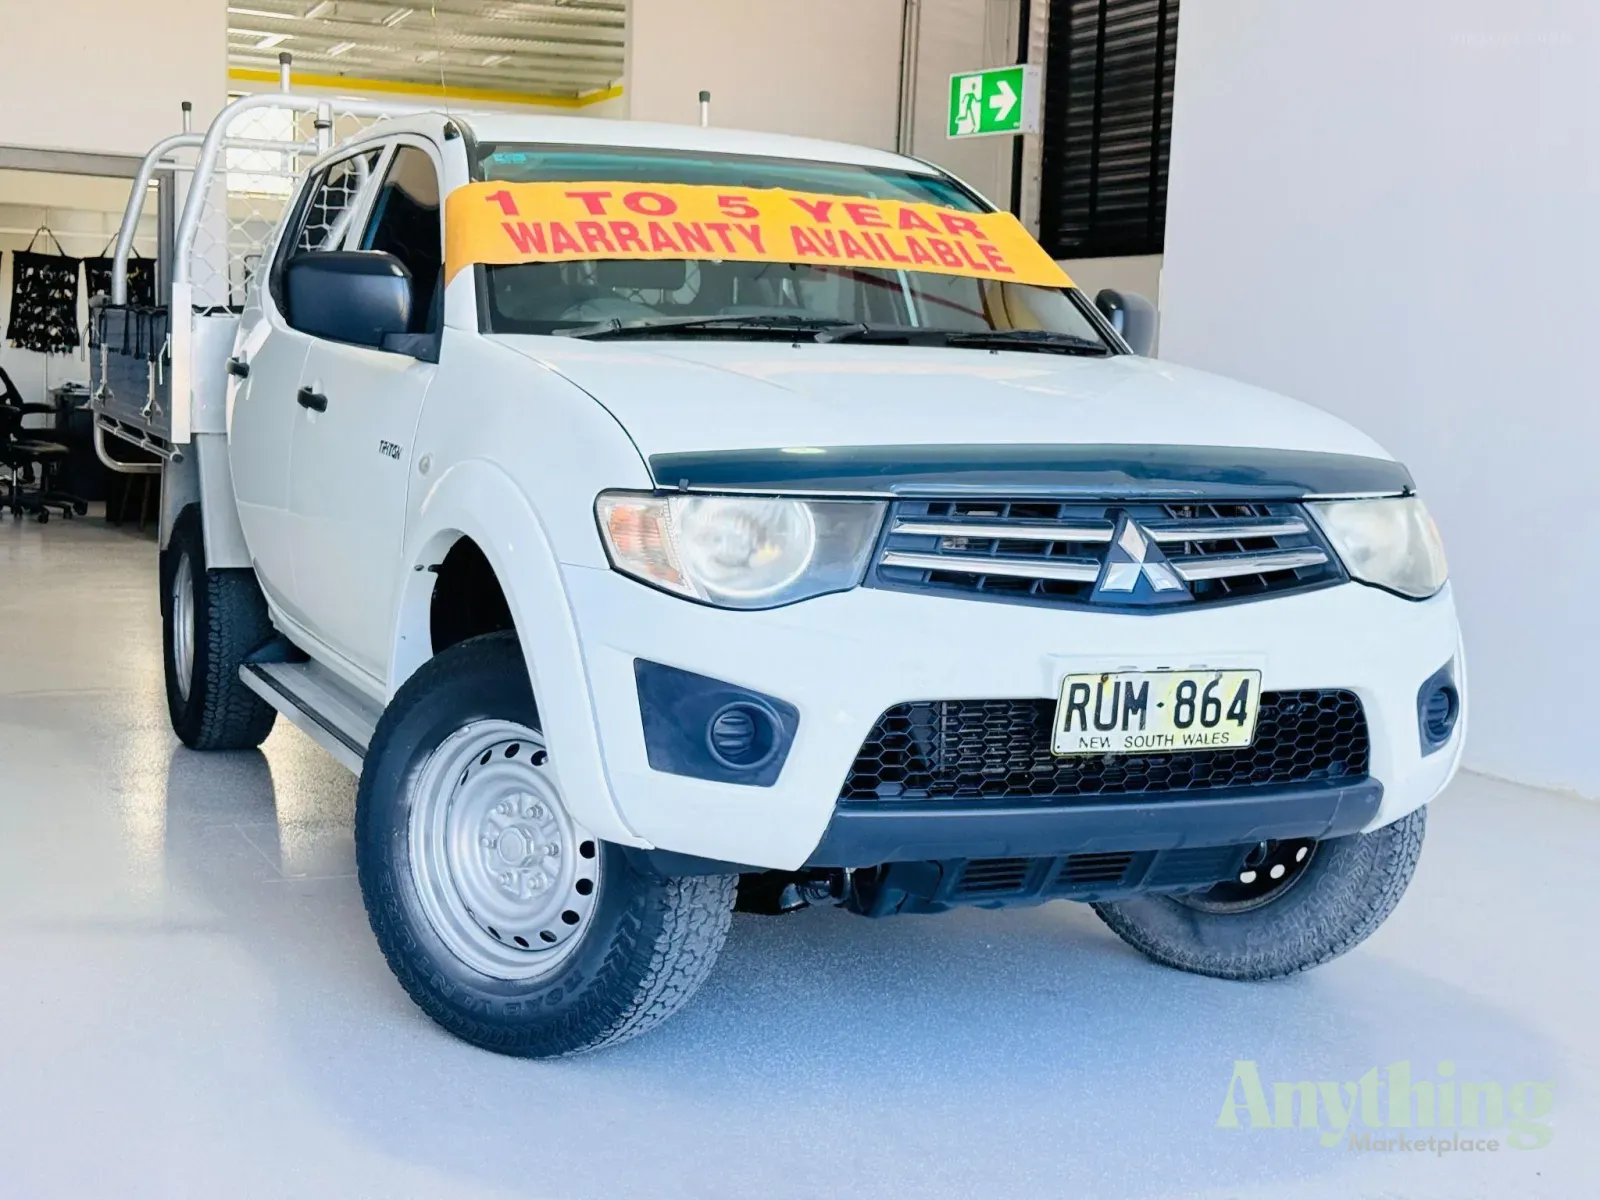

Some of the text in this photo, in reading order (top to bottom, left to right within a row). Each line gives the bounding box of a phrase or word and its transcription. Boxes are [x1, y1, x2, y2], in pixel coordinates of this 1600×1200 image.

[485, 190, 989, 240] 1 TO 5 YEAR
[500, 221, 1016, 274] WARRANTY AVAILABLE
[1063, 678, 1250, 732] RUM 864
[1078, 732, 1230, 750] NEW SOUTH WALES
